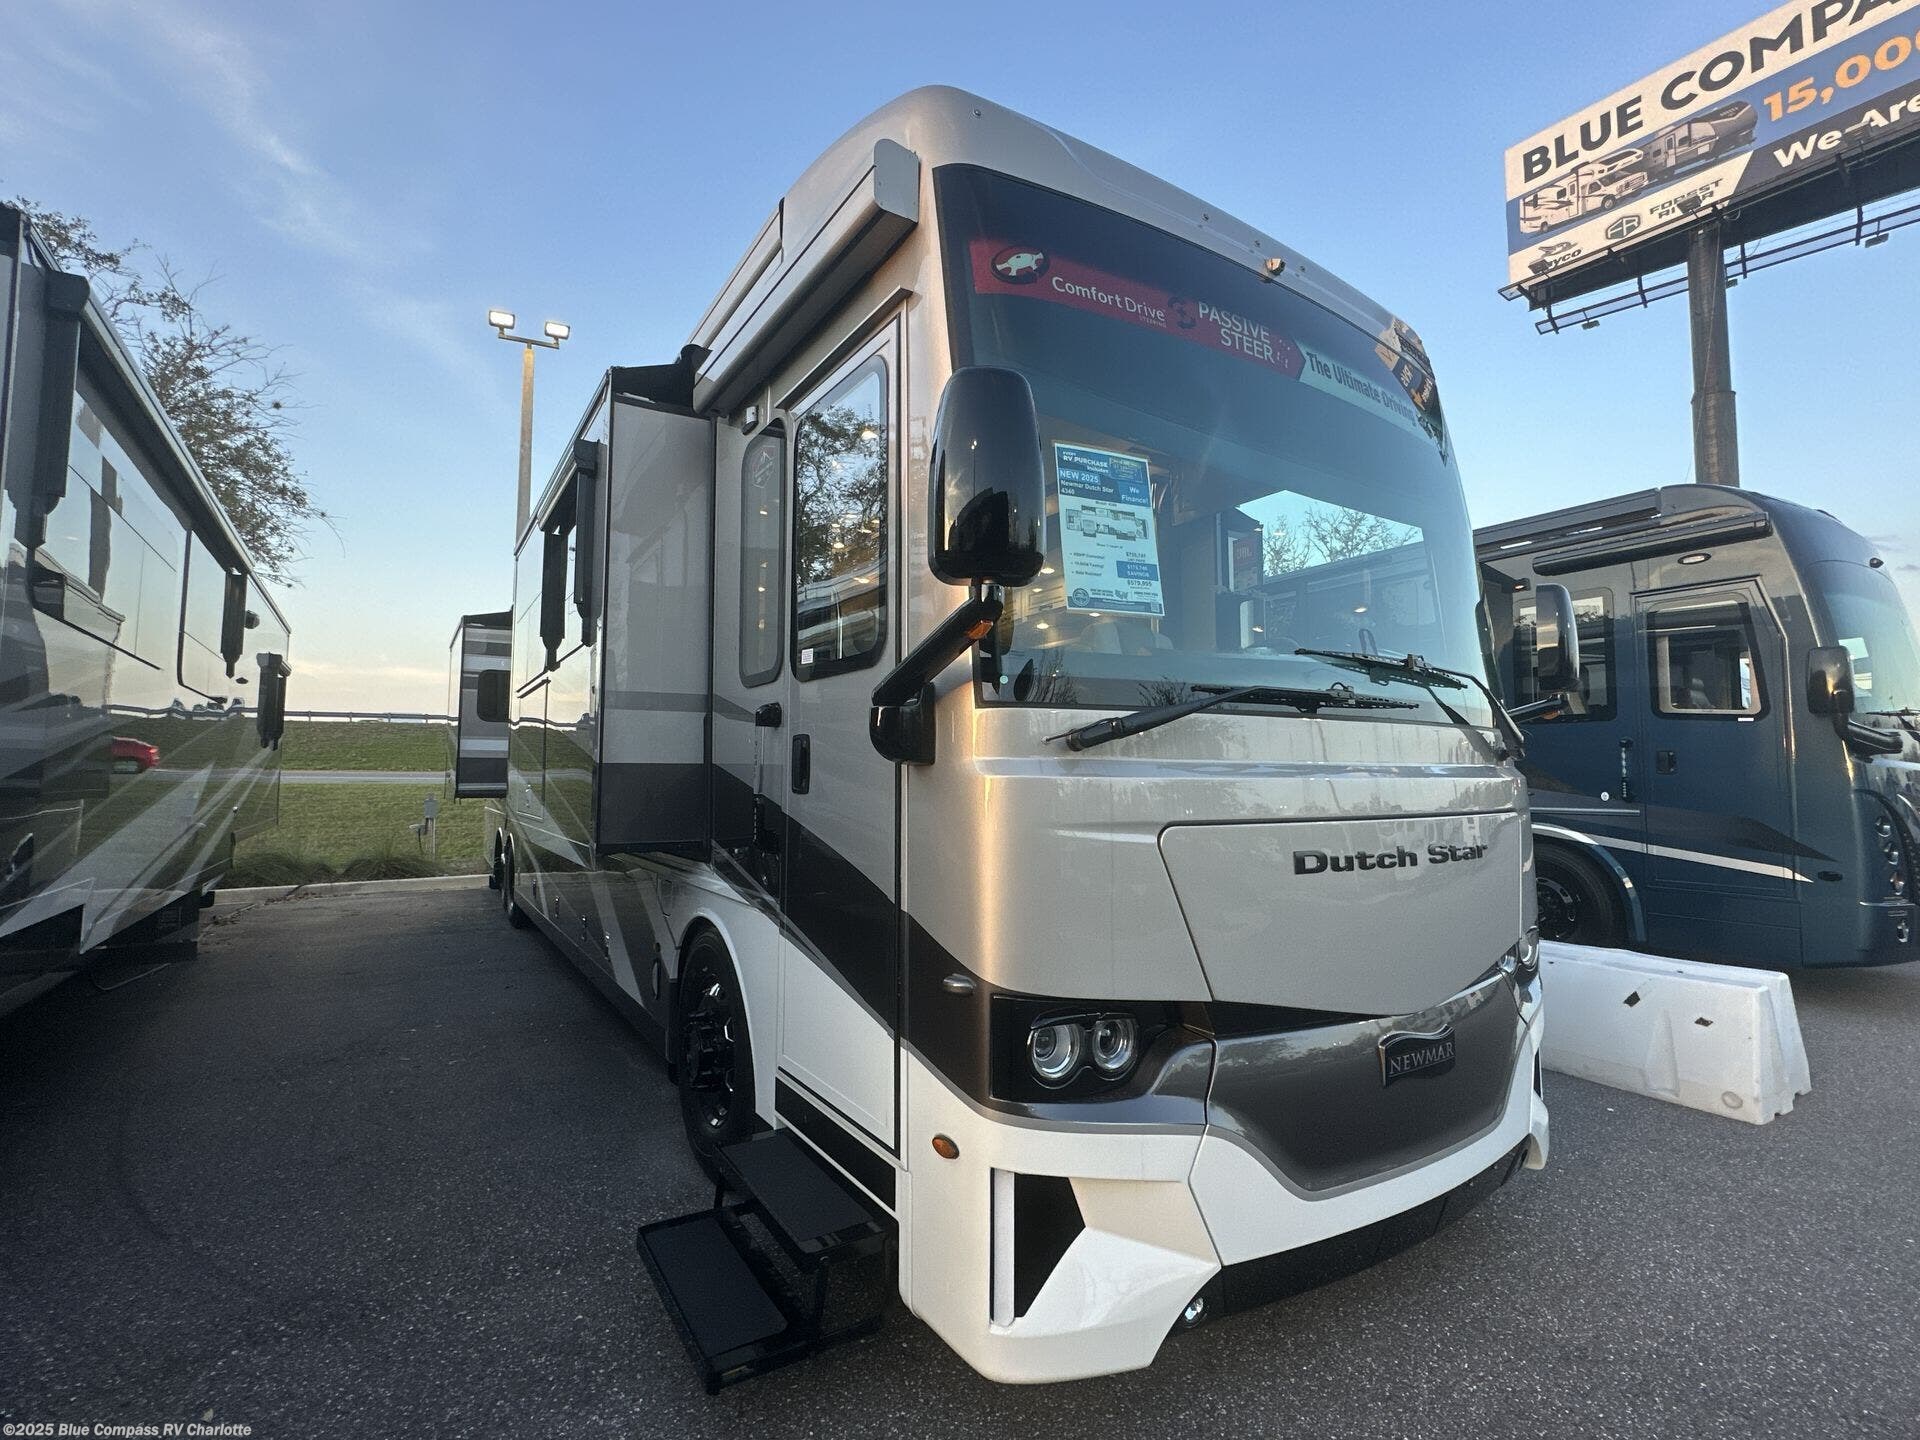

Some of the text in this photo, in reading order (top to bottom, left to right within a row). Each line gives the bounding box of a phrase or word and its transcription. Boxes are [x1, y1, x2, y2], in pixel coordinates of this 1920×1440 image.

[1763, 27, 1920, 121] 15,00
[1523, 95, 1643, 183] BLUE
[1774, 130, 1842, 167] We
[1659, 190, 1714, 219] RIR
[1198, 301, 1271, 344] PASSIVE
[1221, 328, 1275, 364] STEER
[1306, 351, 1332, 379] The
[1333, 363, 1381, 403] Ultimate
[1060, 470, 1099, 483] NEW 2025
[1074, 456, 1108, 468] PURCHASE
[1061, 480, 1084, 489] Newmar
[1085, 483, 1101, 491] Dutch
[1121, 494, 1149, 504] Finance!
[1129, 486, 1140, 494] We
[1293, 842, 1488, 875] Dutch Star
[1388, 1042, 1454, 1075] NEWMAR
